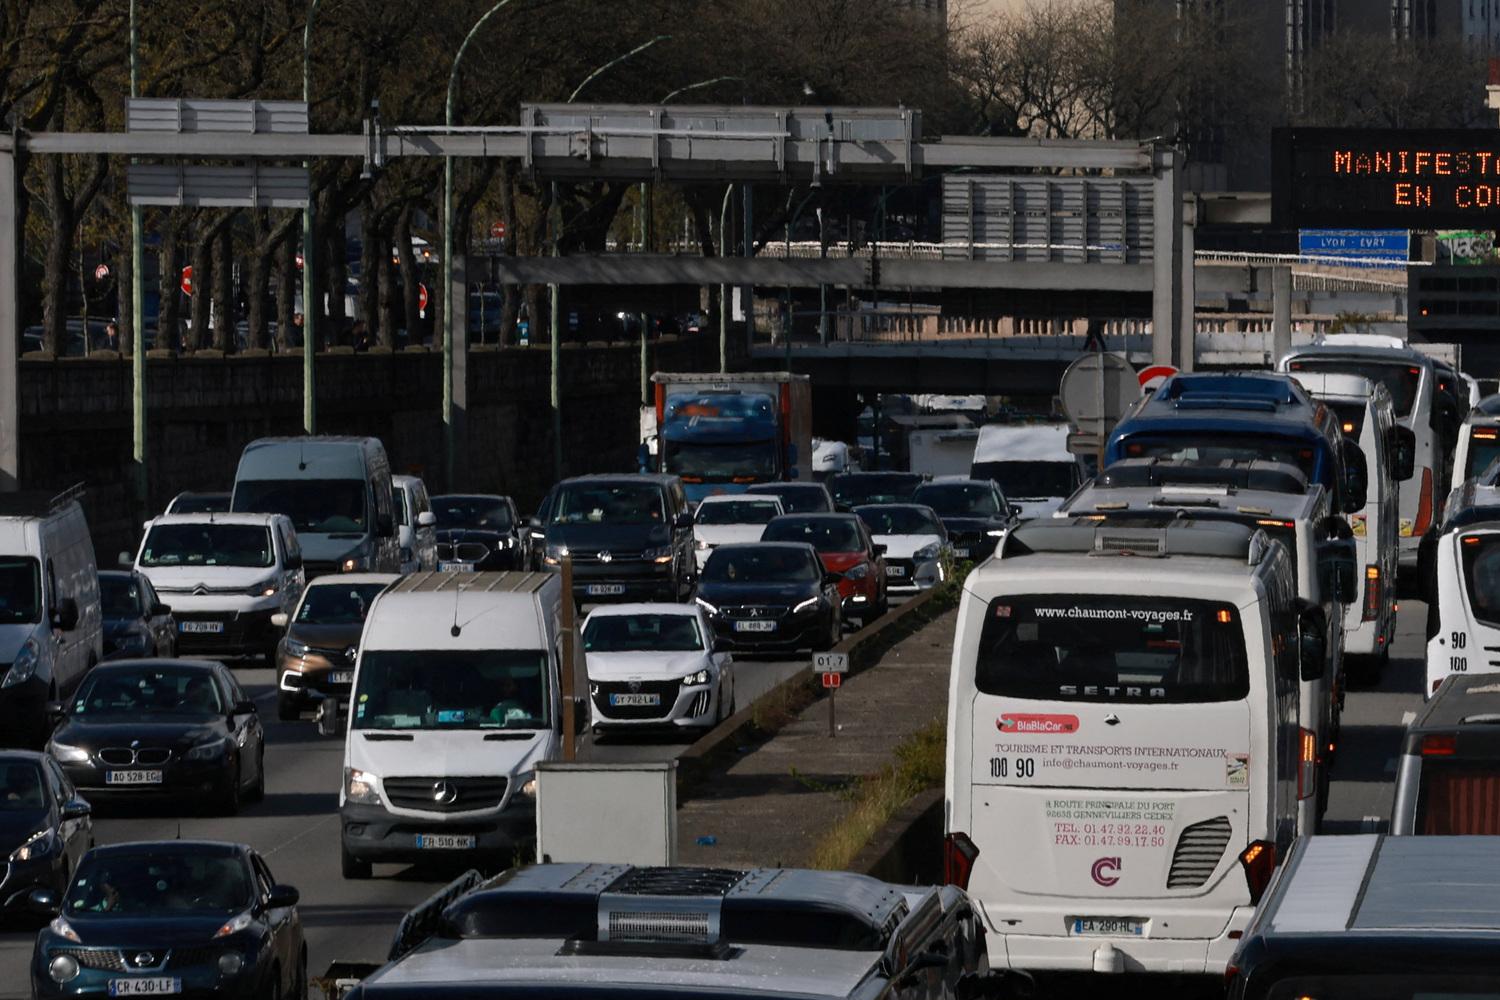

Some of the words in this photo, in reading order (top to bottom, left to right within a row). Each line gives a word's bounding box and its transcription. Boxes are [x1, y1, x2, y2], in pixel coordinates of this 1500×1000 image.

[1395, 184, 1431, 206] EN
[1034, 606, 1193, 622] www.chaumont-voyages.fr
[1451, 631, 1466, 649] 90
[1449, 656, 1468, 672] 100
[1059, 685, 1166, 697] SETRA
[1017, 720, 1063, 732] BlaBlaCar
[995, 743, 1049, 755] TOURISME
[1051, 744, 1064, 755] ET
[1067, 745, 1133, 757] TRANSPORTS
[1134, 747, 1228, 759] INTERNATIONAUX
[990, 758, 1008, 778] 100
[1016, 758, 1035, 778] 90
[1043, 757, 1179, 772] info@chaumont-voyages.fr
[1053, 800, 1084, 811] ROUTE
[1085, 801, 1135, 811] PRINCIPALE
[1137, 802, 1151, 810] DU
[1152, 802, 1175, 811] PORT
[1073, 810, 1142, 821] GENNEVILLIERS
[1143, 812, 1174, 821] CEDEX
[1055, 823, 1081, 834] TEL.
[1055, 835, 1081, 846] FAX:
